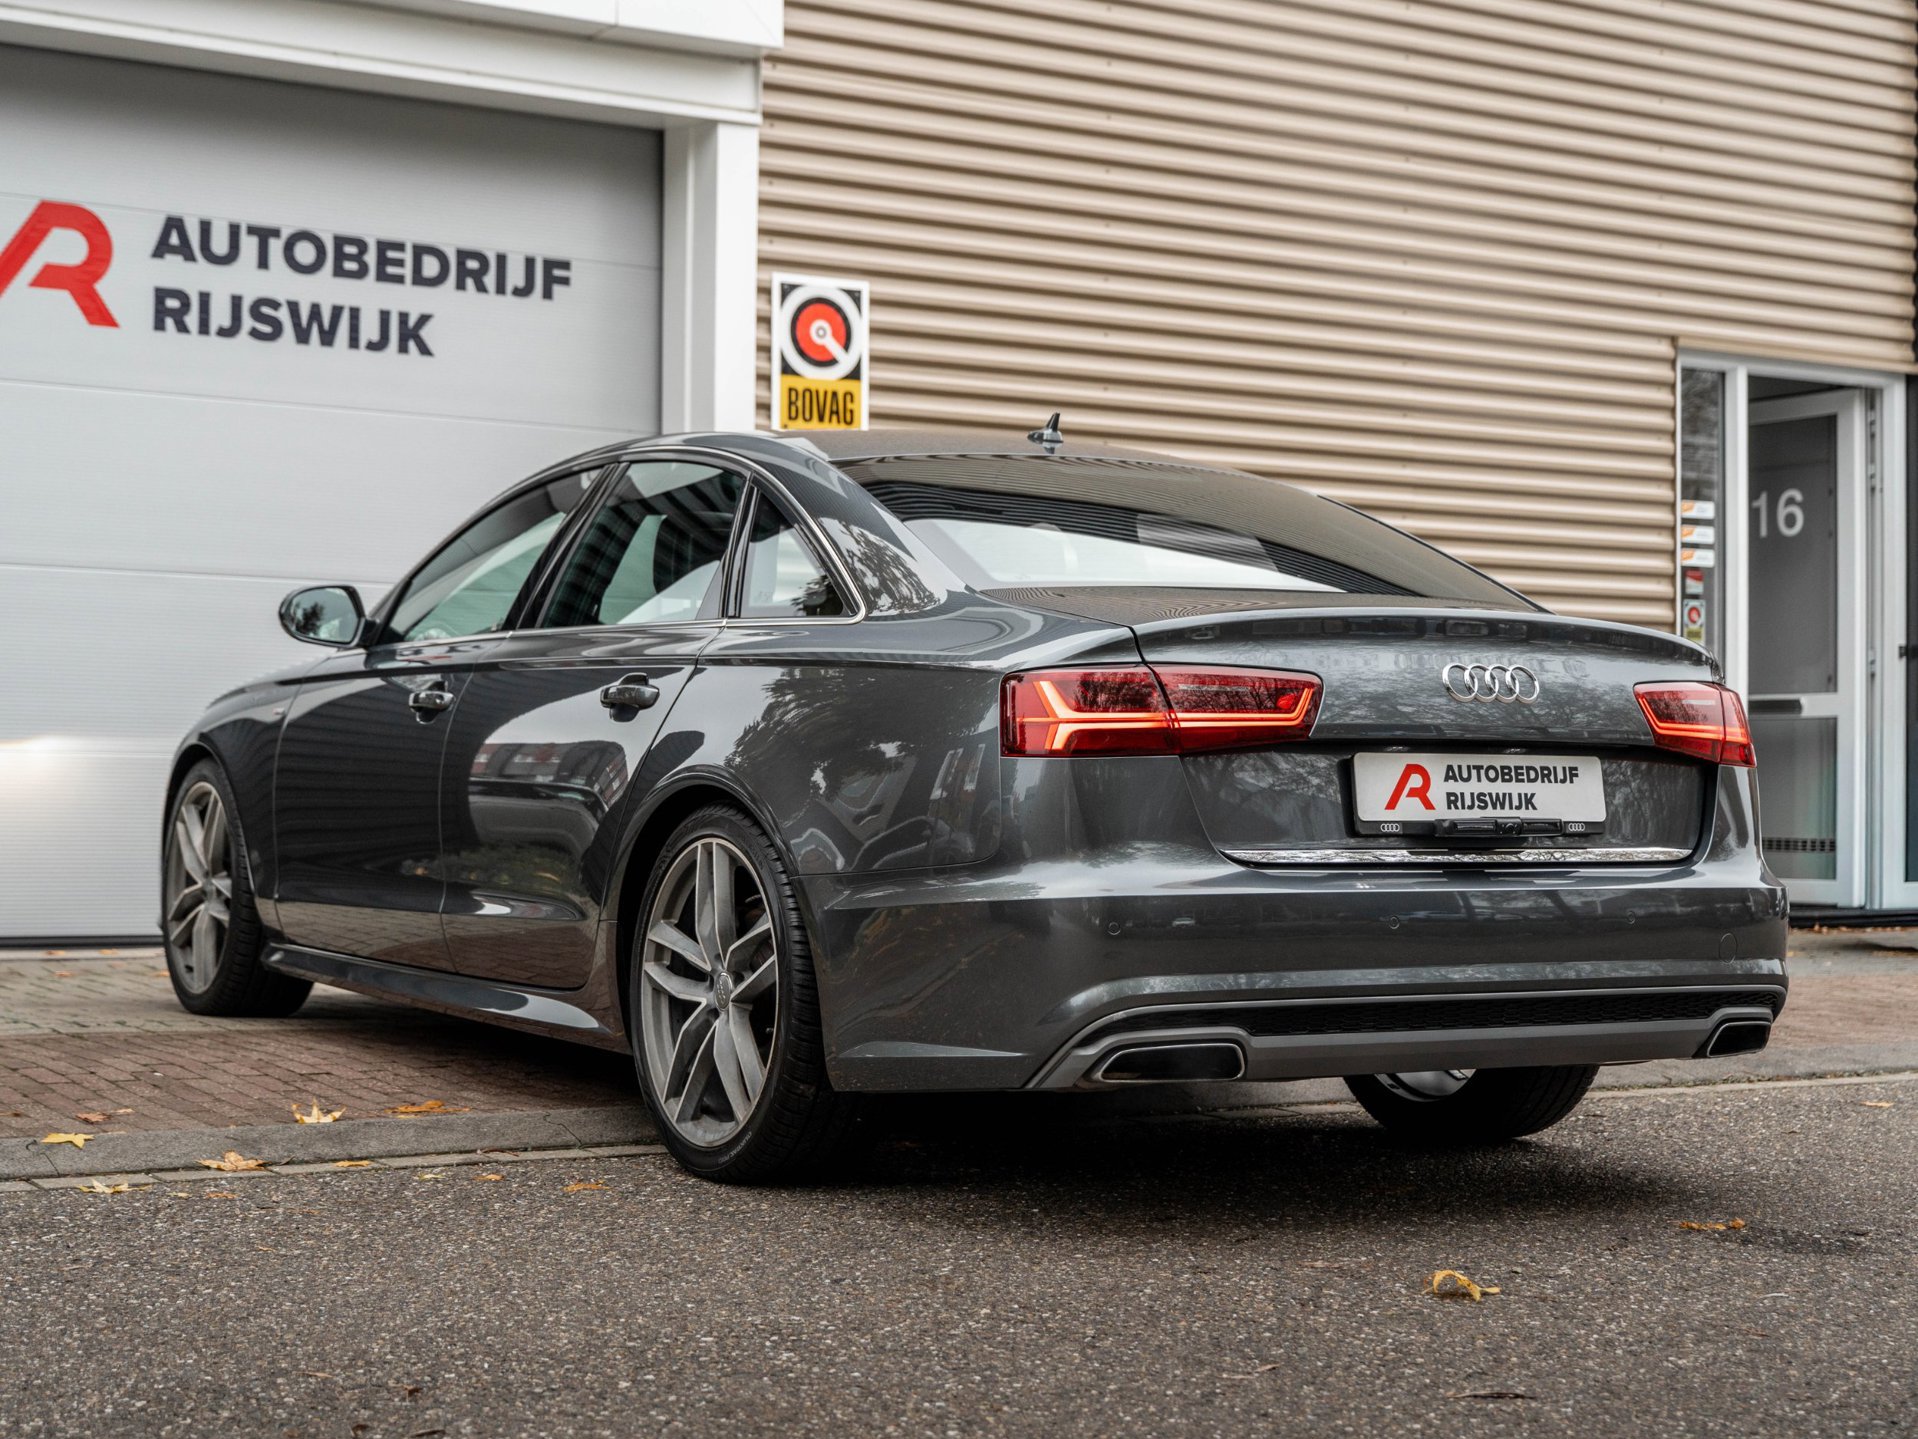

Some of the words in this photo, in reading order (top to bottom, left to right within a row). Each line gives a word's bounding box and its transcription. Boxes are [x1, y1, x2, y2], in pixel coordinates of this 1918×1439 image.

[151, 214, 572, 302] AUTOBEDRIJF
[152, 286, 434, 358] RIJSWIJK
[787, 387, 855, 426] BOVAG
[1752, 488, 1805, 538] 16
[1443, 764, 1579, 785] AUTOBEDRIJF
[1445, 791, 1538, 811] RIJSWIJK
